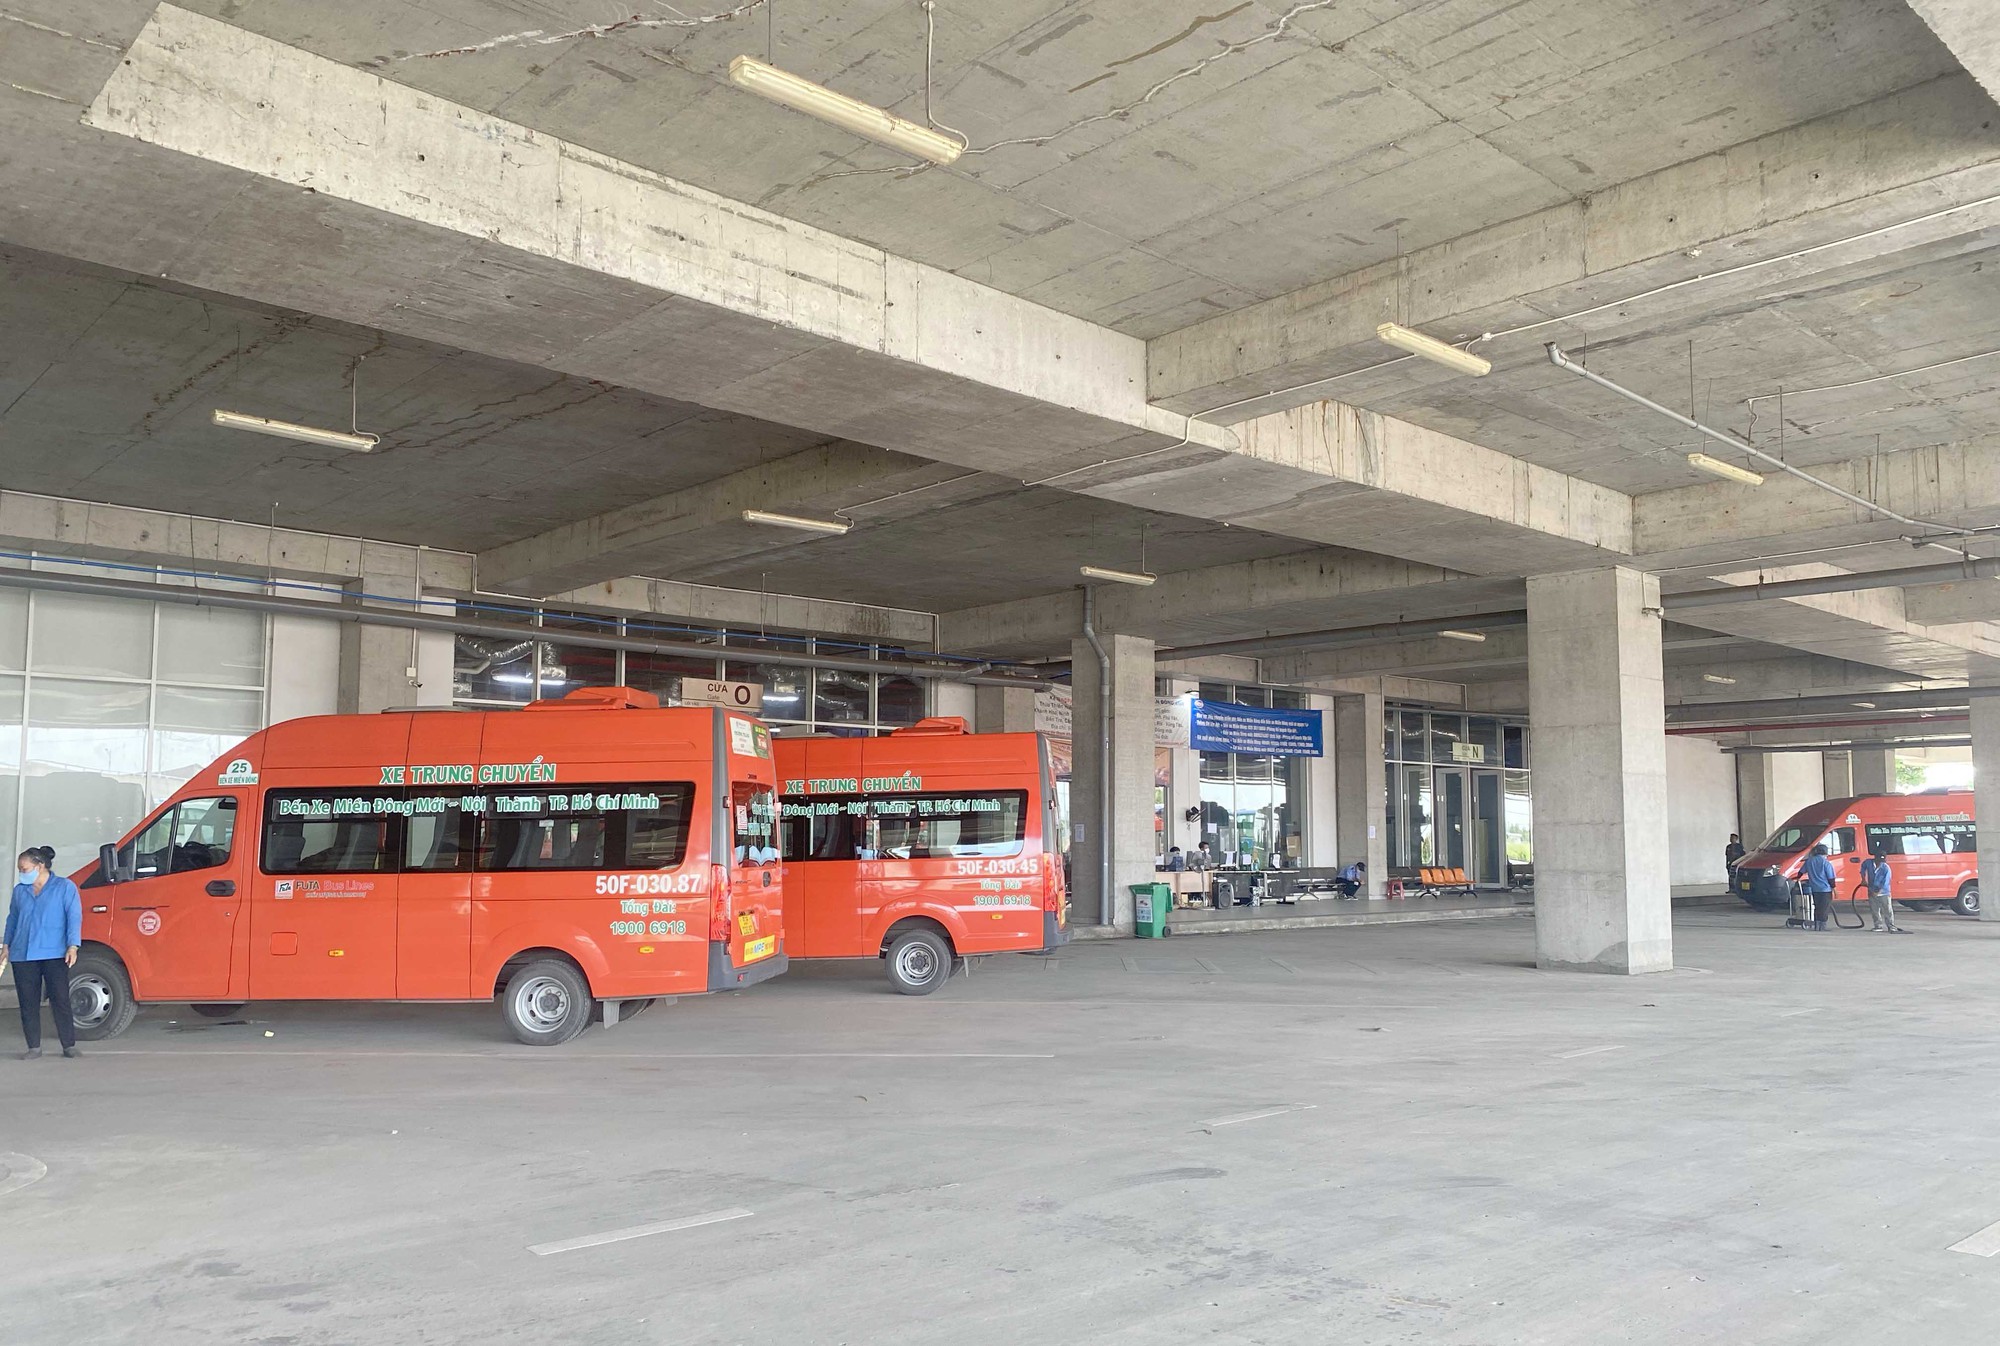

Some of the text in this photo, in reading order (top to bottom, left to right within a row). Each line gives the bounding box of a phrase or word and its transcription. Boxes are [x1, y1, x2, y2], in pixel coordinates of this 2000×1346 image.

[708, 683, 751, 705] CỬA O
[1473, 746, 1478, 758] N
[231, 762, 247, 773] 25
[380, 755, 557, 784] XE TRUNG CHUYỂN
[786, 770, 922, 794] XE TRUNG CHUYỂN
[280, 793, 659, 816] Bến Xe Miền Đông Mới Nội Thành TP. Hồ Chí Minh
[783, 803, 814, 818] Đông
[816, 802, 839, 815] Mới
[847, 801, 867, 817] Nội
[876, 800, 911, 813] Thành
[918, 800, 933, 812] TP.
[953, 799, 971, 812] Chí
[971, 799, 1001, 812] Minh
[958, 859, 1038, 875] 50F-030.45
[295, 880, 374, 890] FUTA Bus Lines
[596, 874, 701, 894] 50F-030.87
[973, 894, 1031, 906] 1900 6918
[610, 920, 687, 935] 1900 6918
